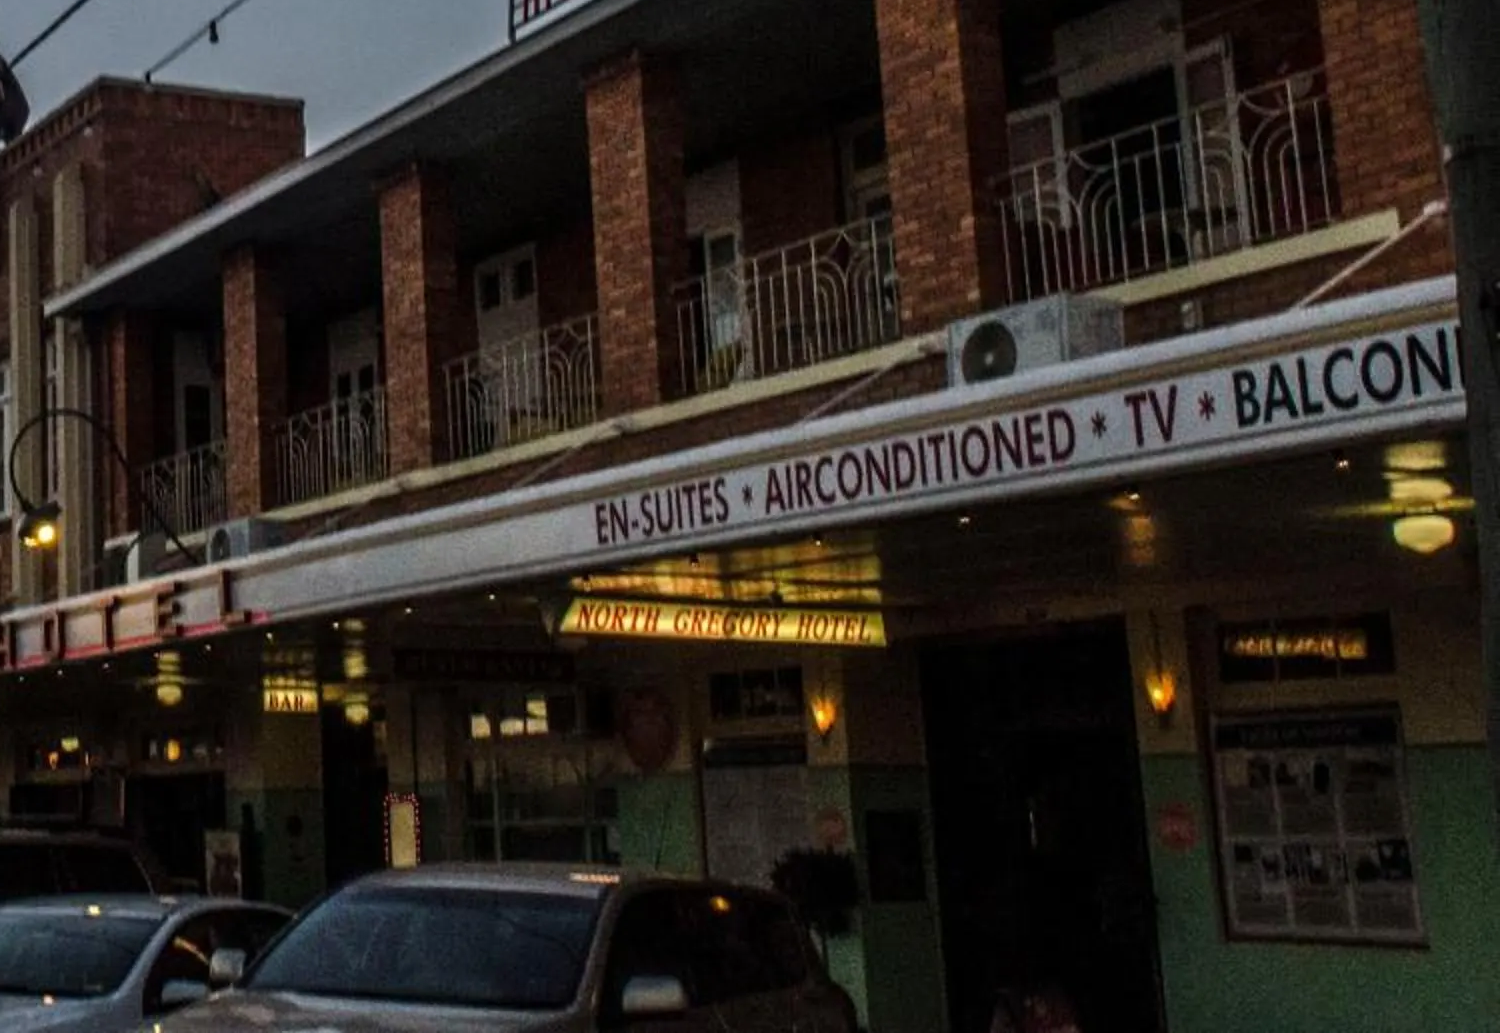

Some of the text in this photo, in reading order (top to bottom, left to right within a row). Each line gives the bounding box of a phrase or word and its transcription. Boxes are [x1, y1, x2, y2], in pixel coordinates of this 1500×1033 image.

[594, 476, 729, 545] EN-SUITES
[764, 408, 1076, 515] AIRCONDITIONED
[1123, 383, 1178, 448] TV
[575, 601, 871, 643] NORTH GREGORY HOTEL
[269, 693, 304, 710] BAR
